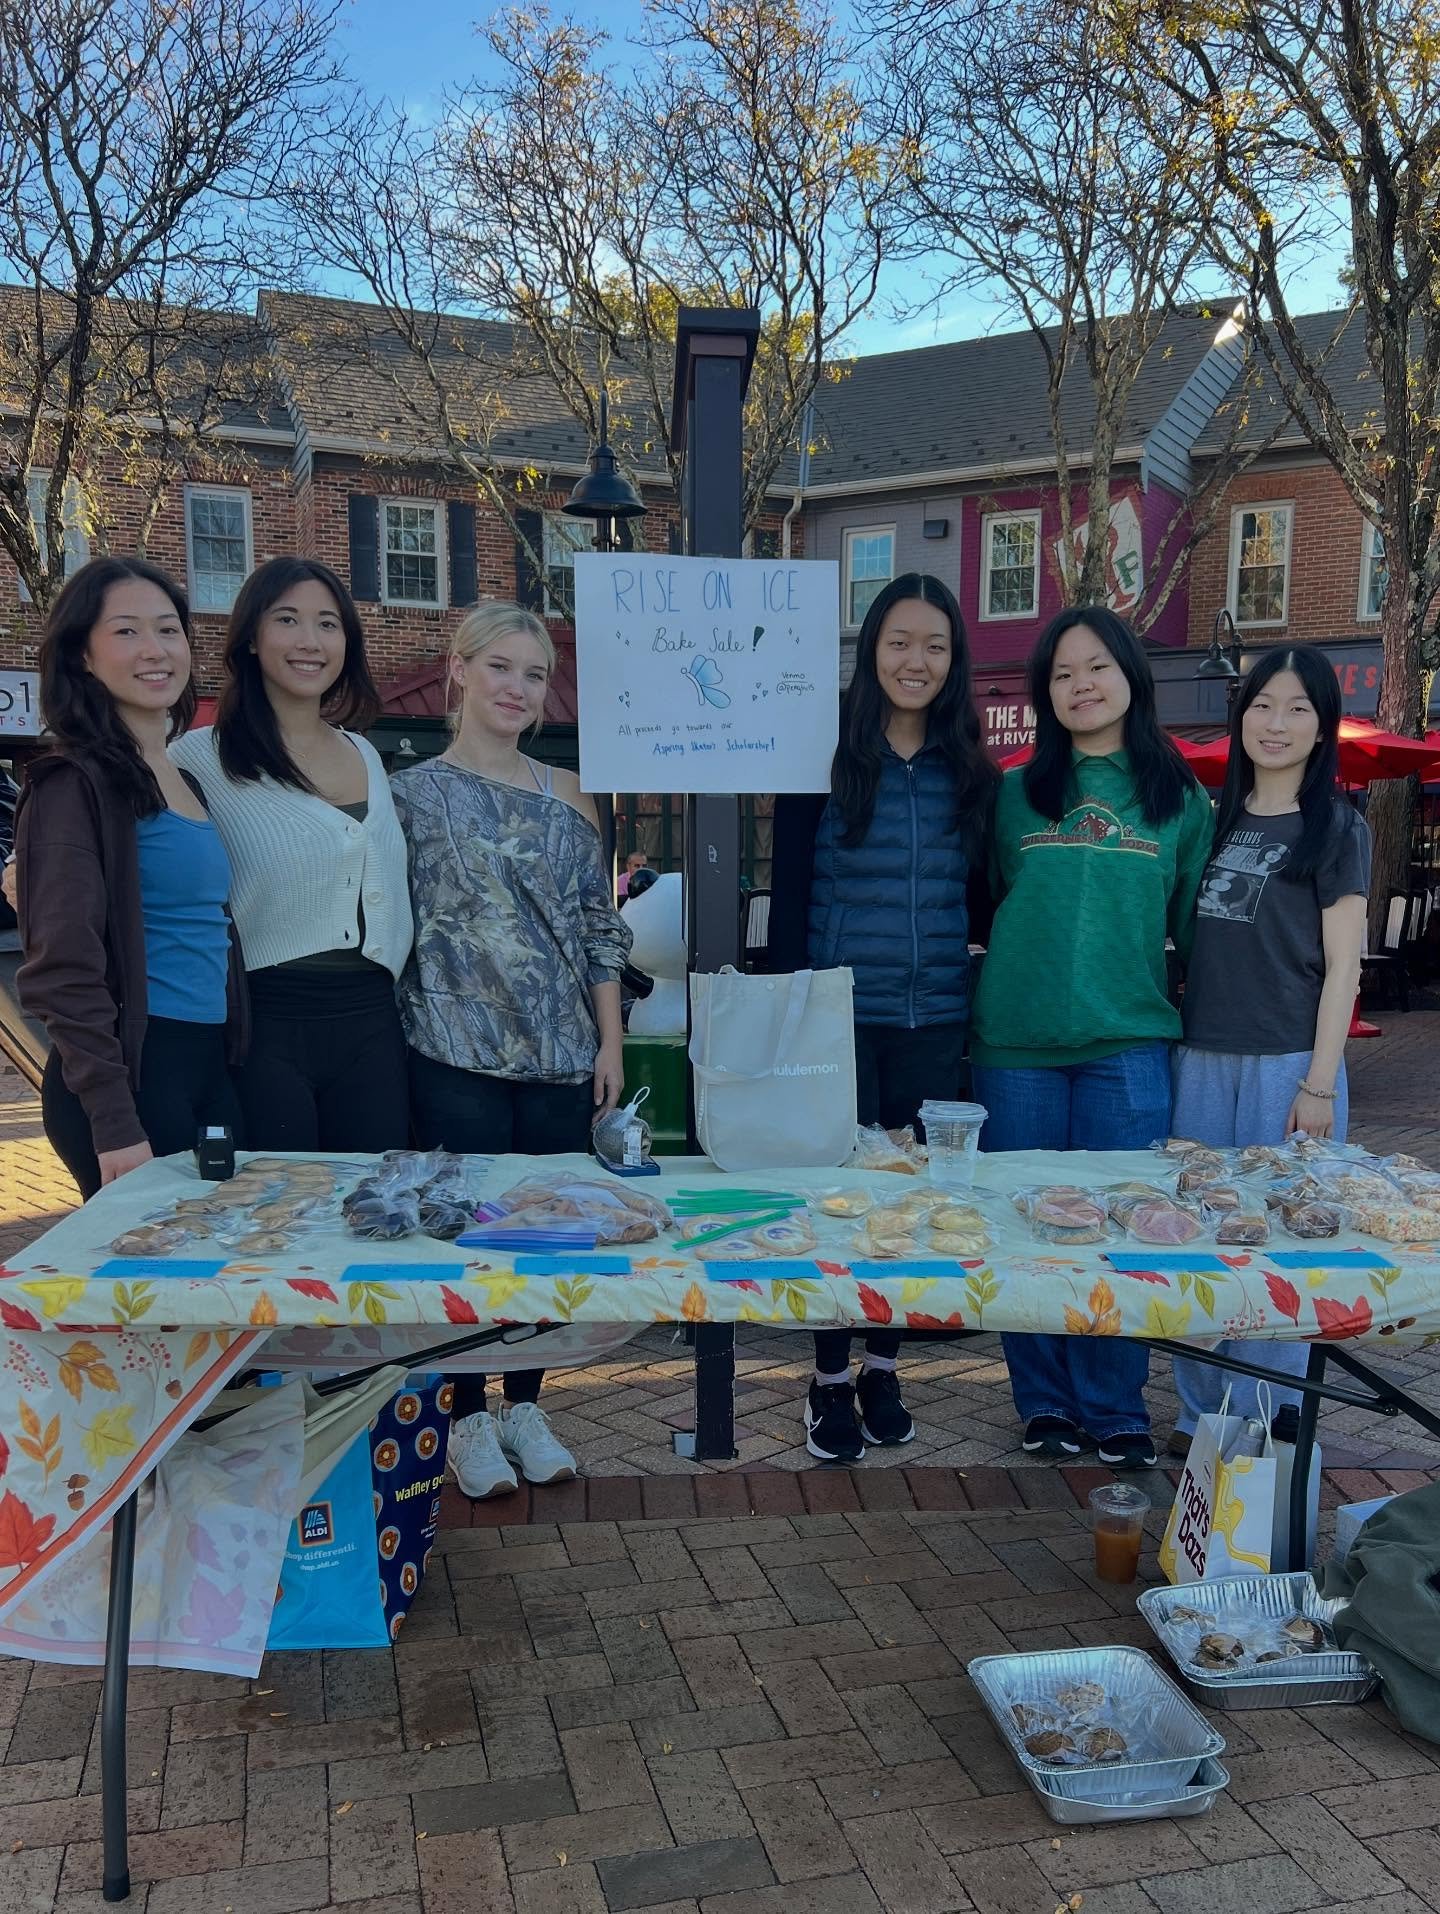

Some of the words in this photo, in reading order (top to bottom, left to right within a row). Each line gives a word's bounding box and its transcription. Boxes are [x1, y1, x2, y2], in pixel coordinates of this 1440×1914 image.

[611, 569, 681, 613] RISE
[703, 570, 733, 610] ON
[763, 570, 801, 612] ICE
[652, 626, 697, 653] Bake
[985, 705, 1018, 729] THE
[618, 724, 632, 736] All
[986, 733, 1001, 746] at
[1003, 731, 1036, 745] RIVE
[394, 1478, 432, 1503] Waffley
[304, 1526, 329, 1539] ALDI
[1177, 1510, 1207, 1578] Dazs
